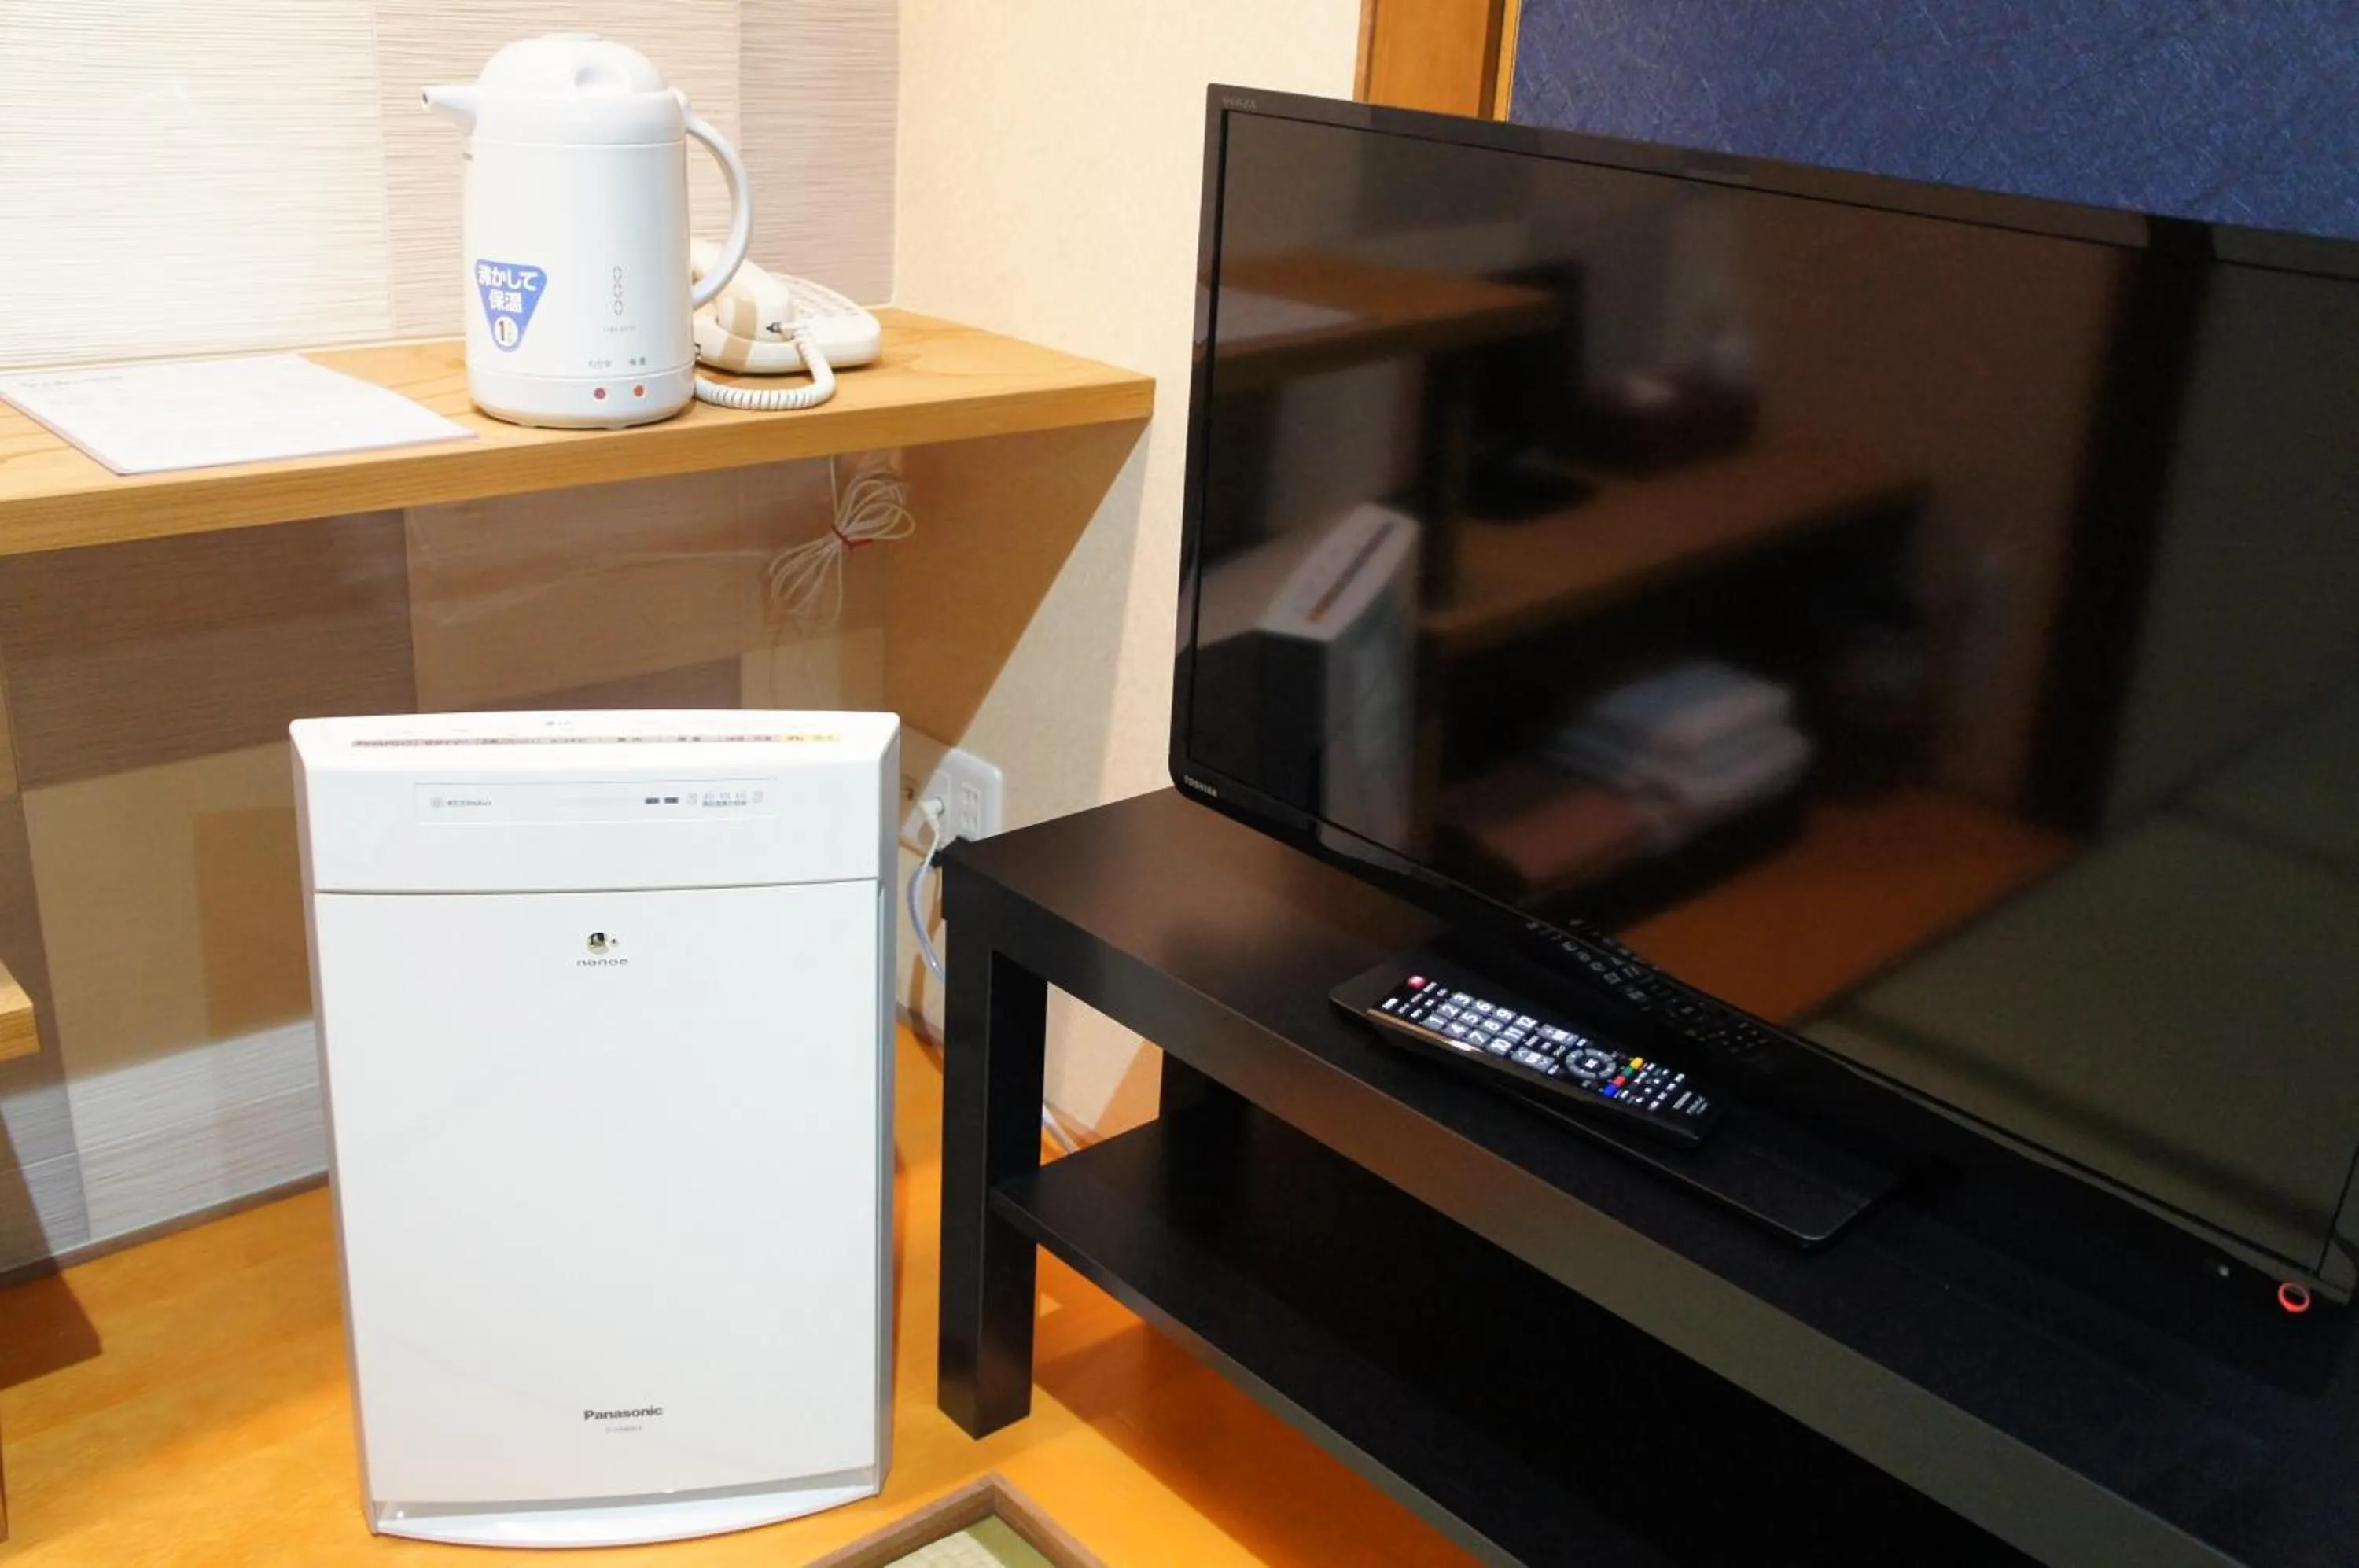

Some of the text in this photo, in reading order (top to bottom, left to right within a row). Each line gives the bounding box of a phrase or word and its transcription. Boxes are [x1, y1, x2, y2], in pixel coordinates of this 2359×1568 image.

[477, 264, 538, 292] 沸かして
[489, 289, 523, 313] 保温
[1491, 1038, 1512, 1051] 10
[1504, 1026, 1525, 1040] 11
[583, 1405, 663, 1421] Panasonic
